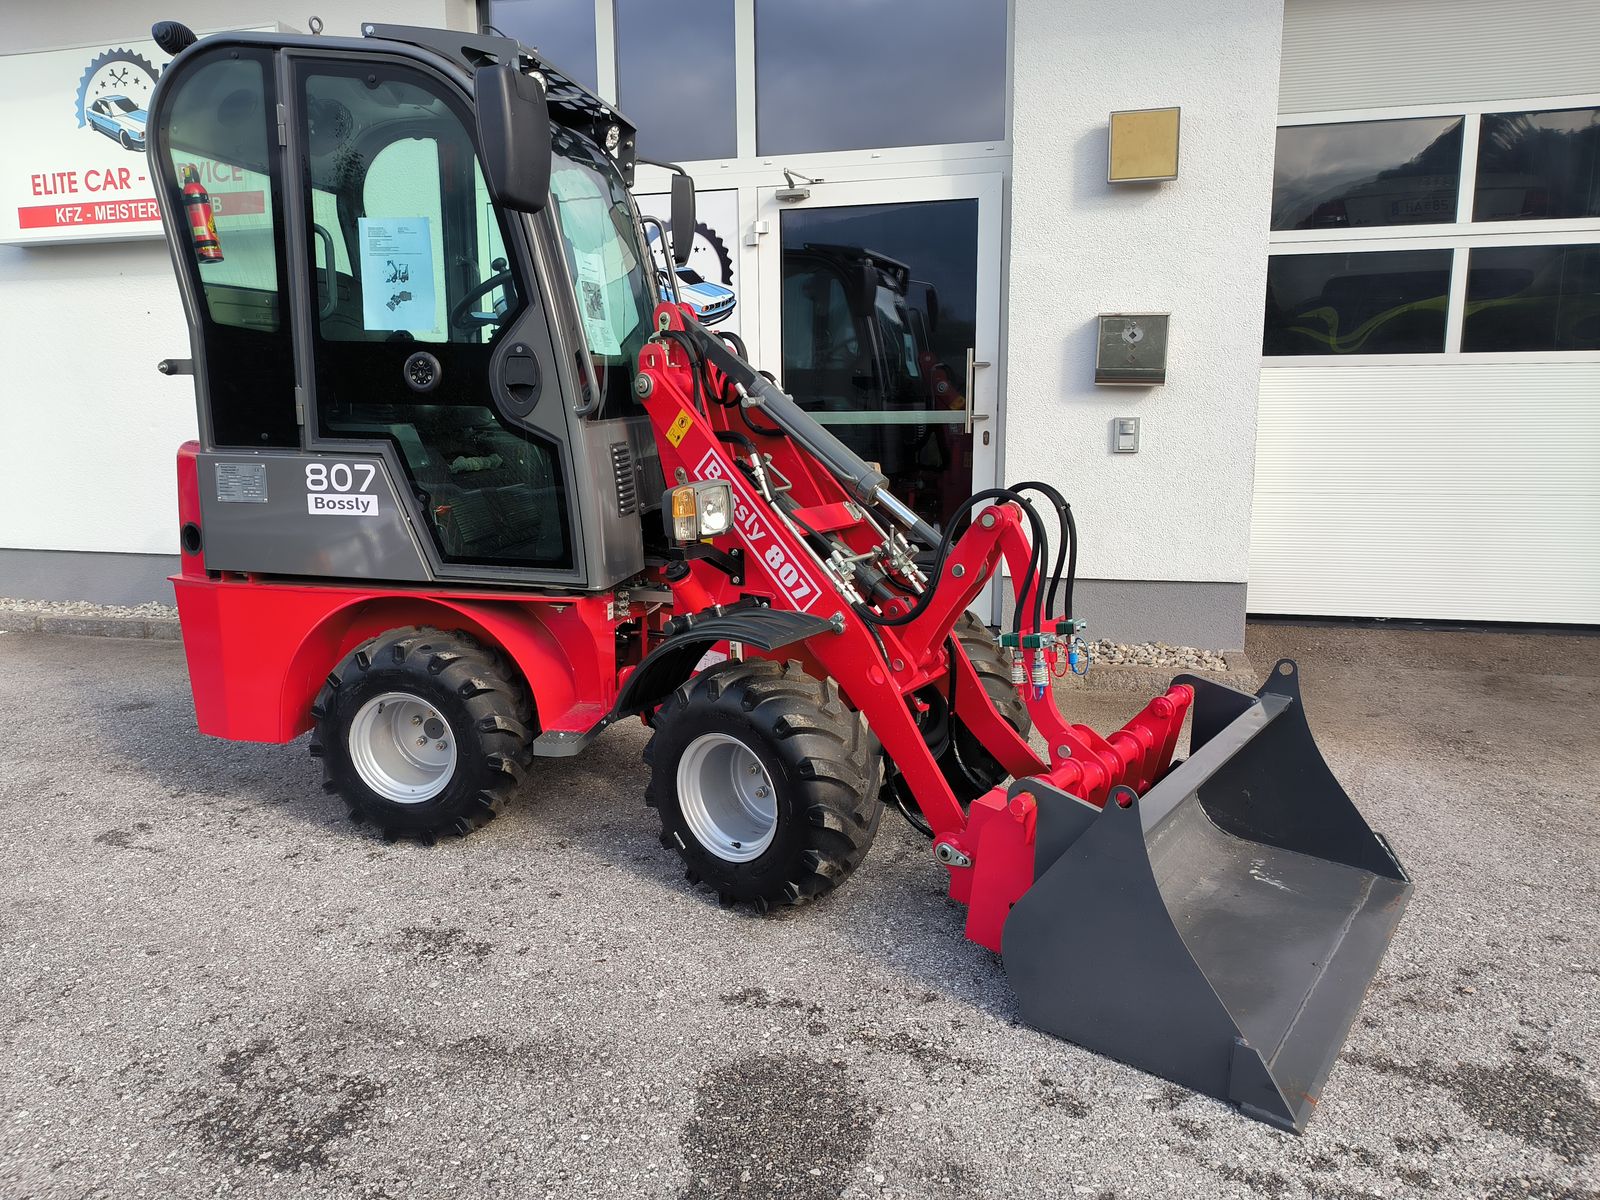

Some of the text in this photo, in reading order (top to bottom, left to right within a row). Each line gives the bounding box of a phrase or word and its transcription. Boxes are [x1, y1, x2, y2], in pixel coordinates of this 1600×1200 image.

[31, 171, 78, 196] ELITE
[84, 167, 132, 192] CAR
[55, 206, 83, 223] KFZ
[305, 463, 376, 492] 807
[314, 497, 370, 513] Bossly
[704, 460, 812, 600] Bssly 807
